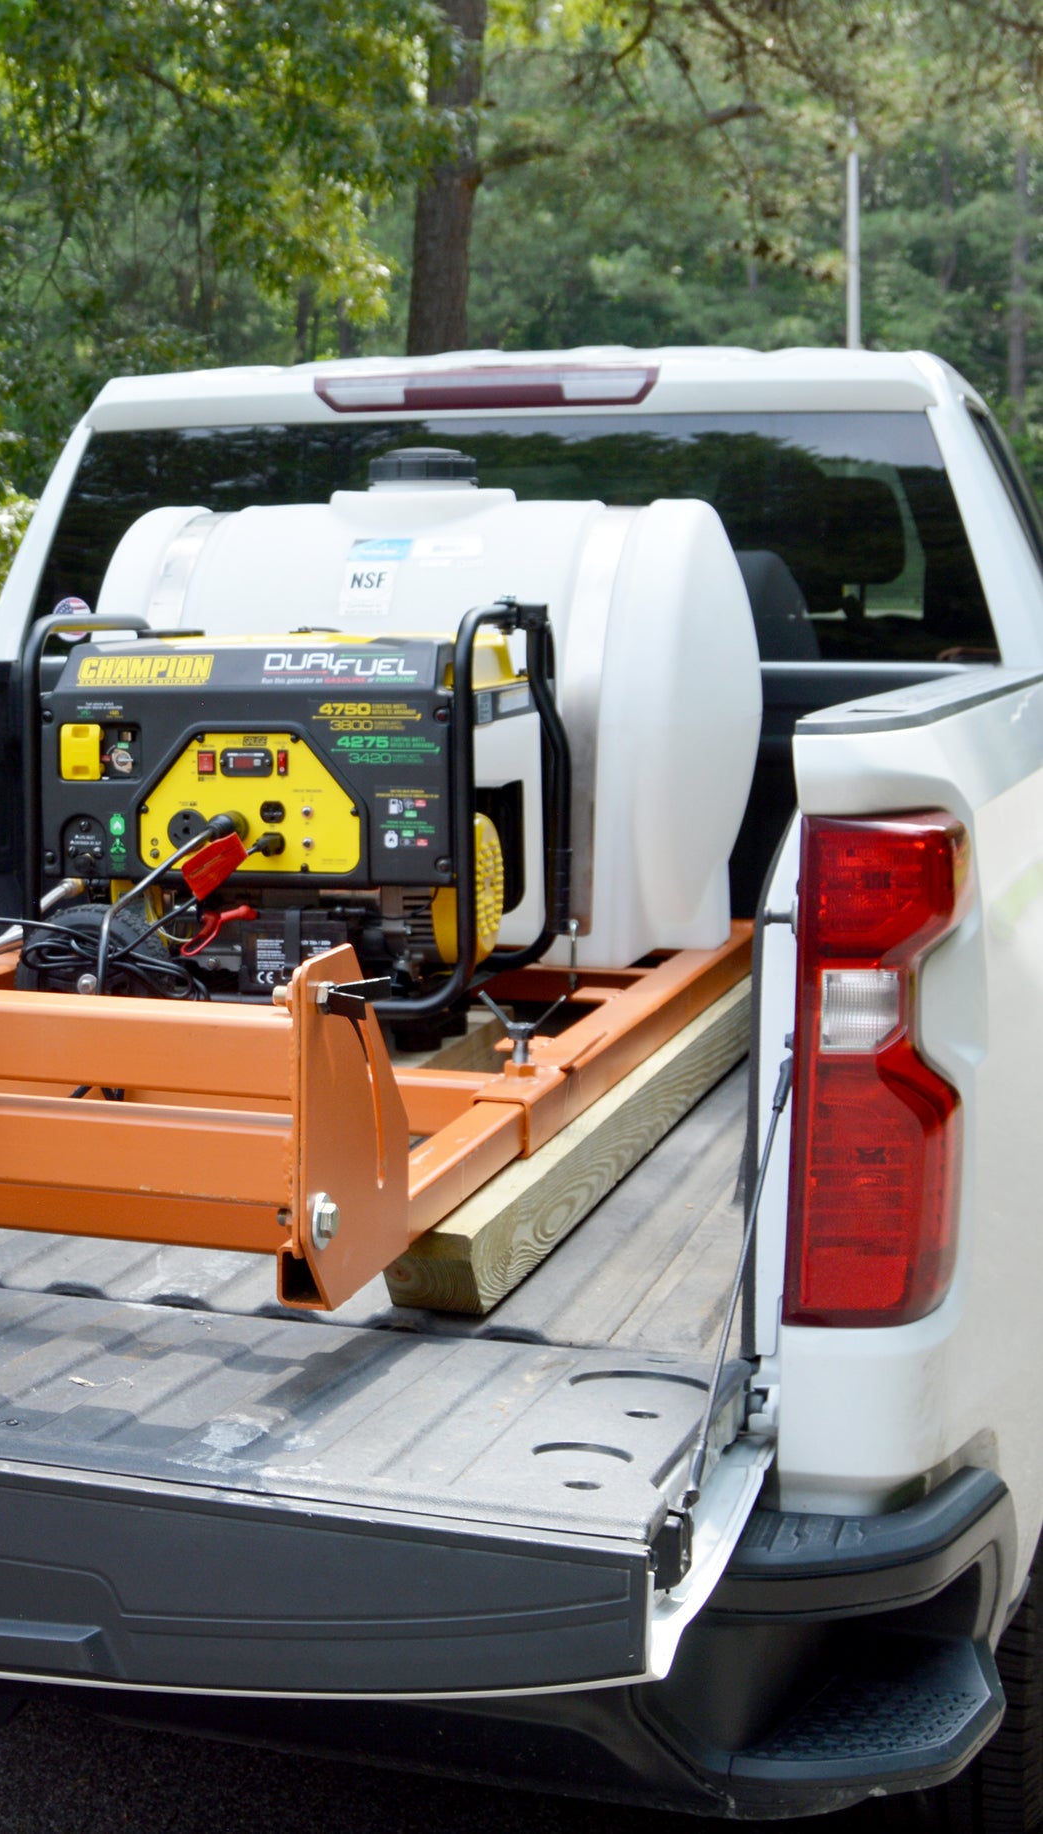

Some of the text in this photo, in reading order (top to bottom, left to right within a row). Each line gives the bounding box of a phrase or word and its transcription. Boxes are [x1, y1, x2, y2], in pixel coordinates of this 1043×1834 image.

[350, 571, 387, 589] NSF
[80, 656, 213, 679] CHAMPION
[263, 653, 418, 676] DUAL FUEL
[318, 702, 372, 716] 4750
[330, 720, 374, 731] 3800
[336, 736, 389, 748] 4275
[348, 753, 392, 764] 3420
